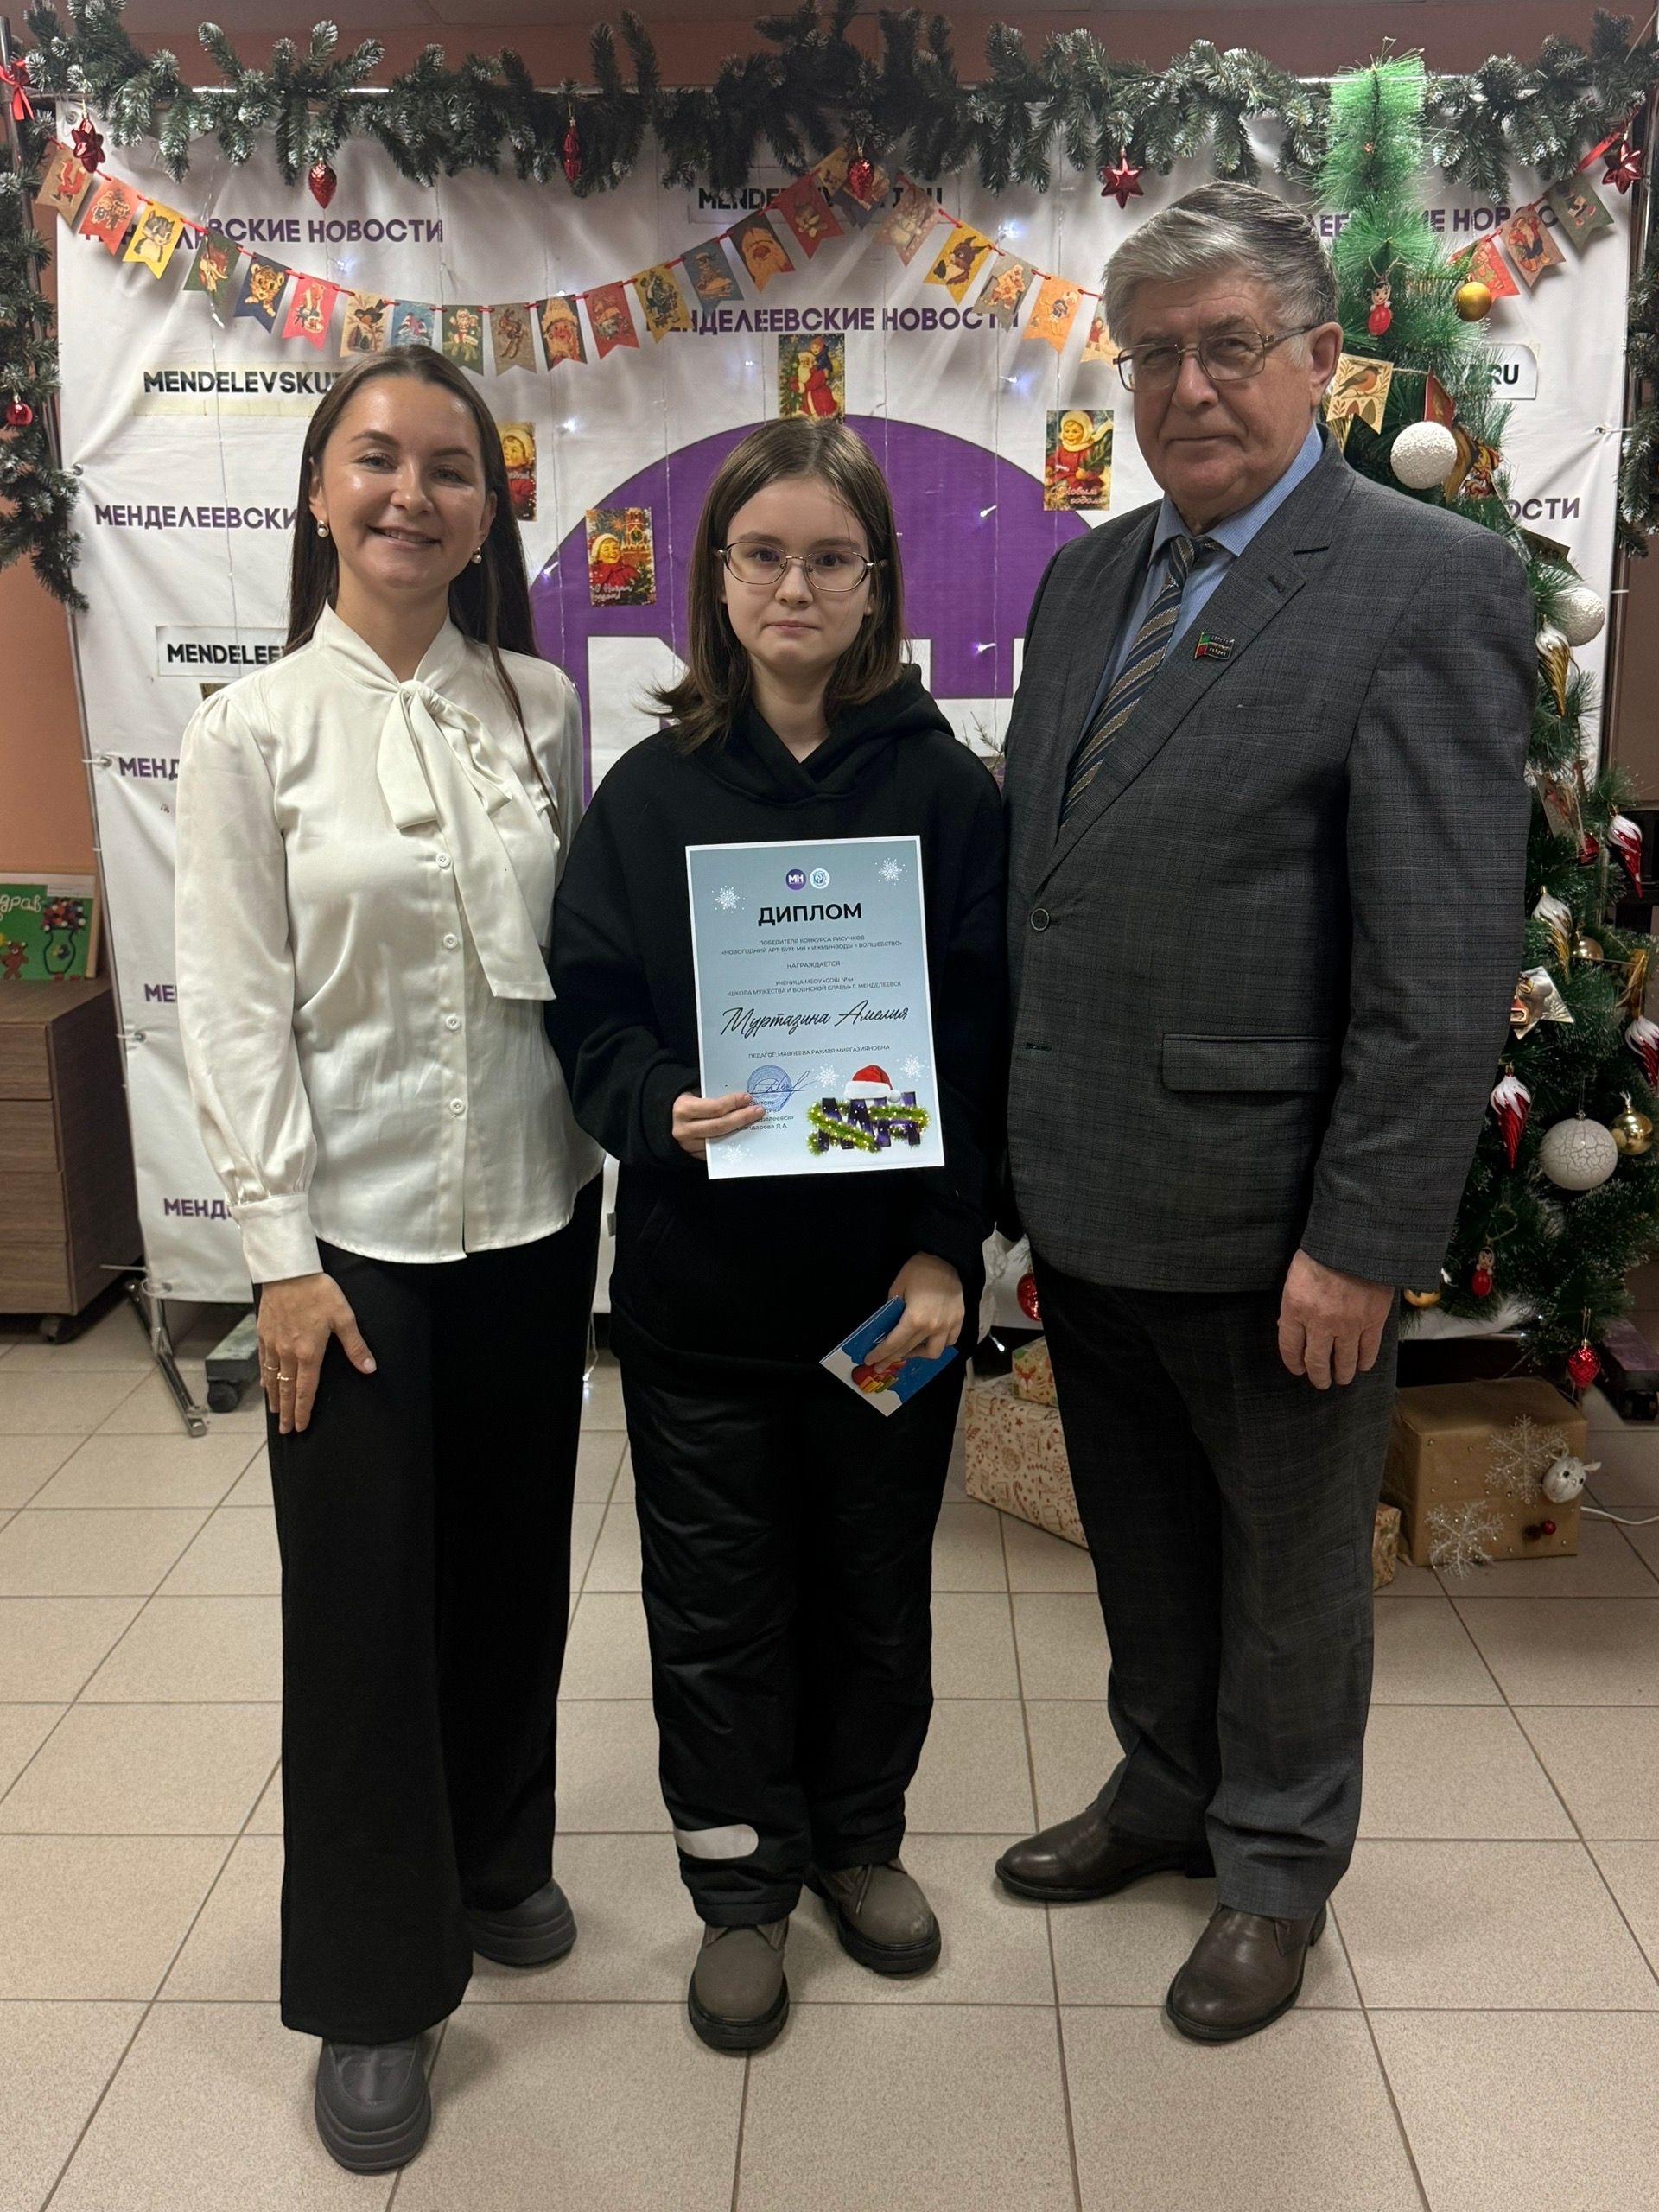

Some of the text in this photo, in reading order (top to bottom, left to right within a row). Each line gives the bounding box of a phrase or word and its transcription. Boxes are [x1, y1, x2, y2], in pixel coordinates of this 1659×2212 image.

[308, 218, 443, 243] НОВОСТИ
[646, 308, 874, 335] ДЕЛЕЕВСКИЕ
[95, 505, 297, 530] МЕНДЕЛЕЕВСКИ
[1505, 497, 1580, 520] ОСТИ
[167, 644, 285, 664] MENDELEE
[118, 756, 180, 781] МЕНД
[758, 903, 861, 926] ДИПЛОМ
[720, 1000, 909, 1038] Муртазина Амелия
[163, 1198, 232, 1220] МЕНД
